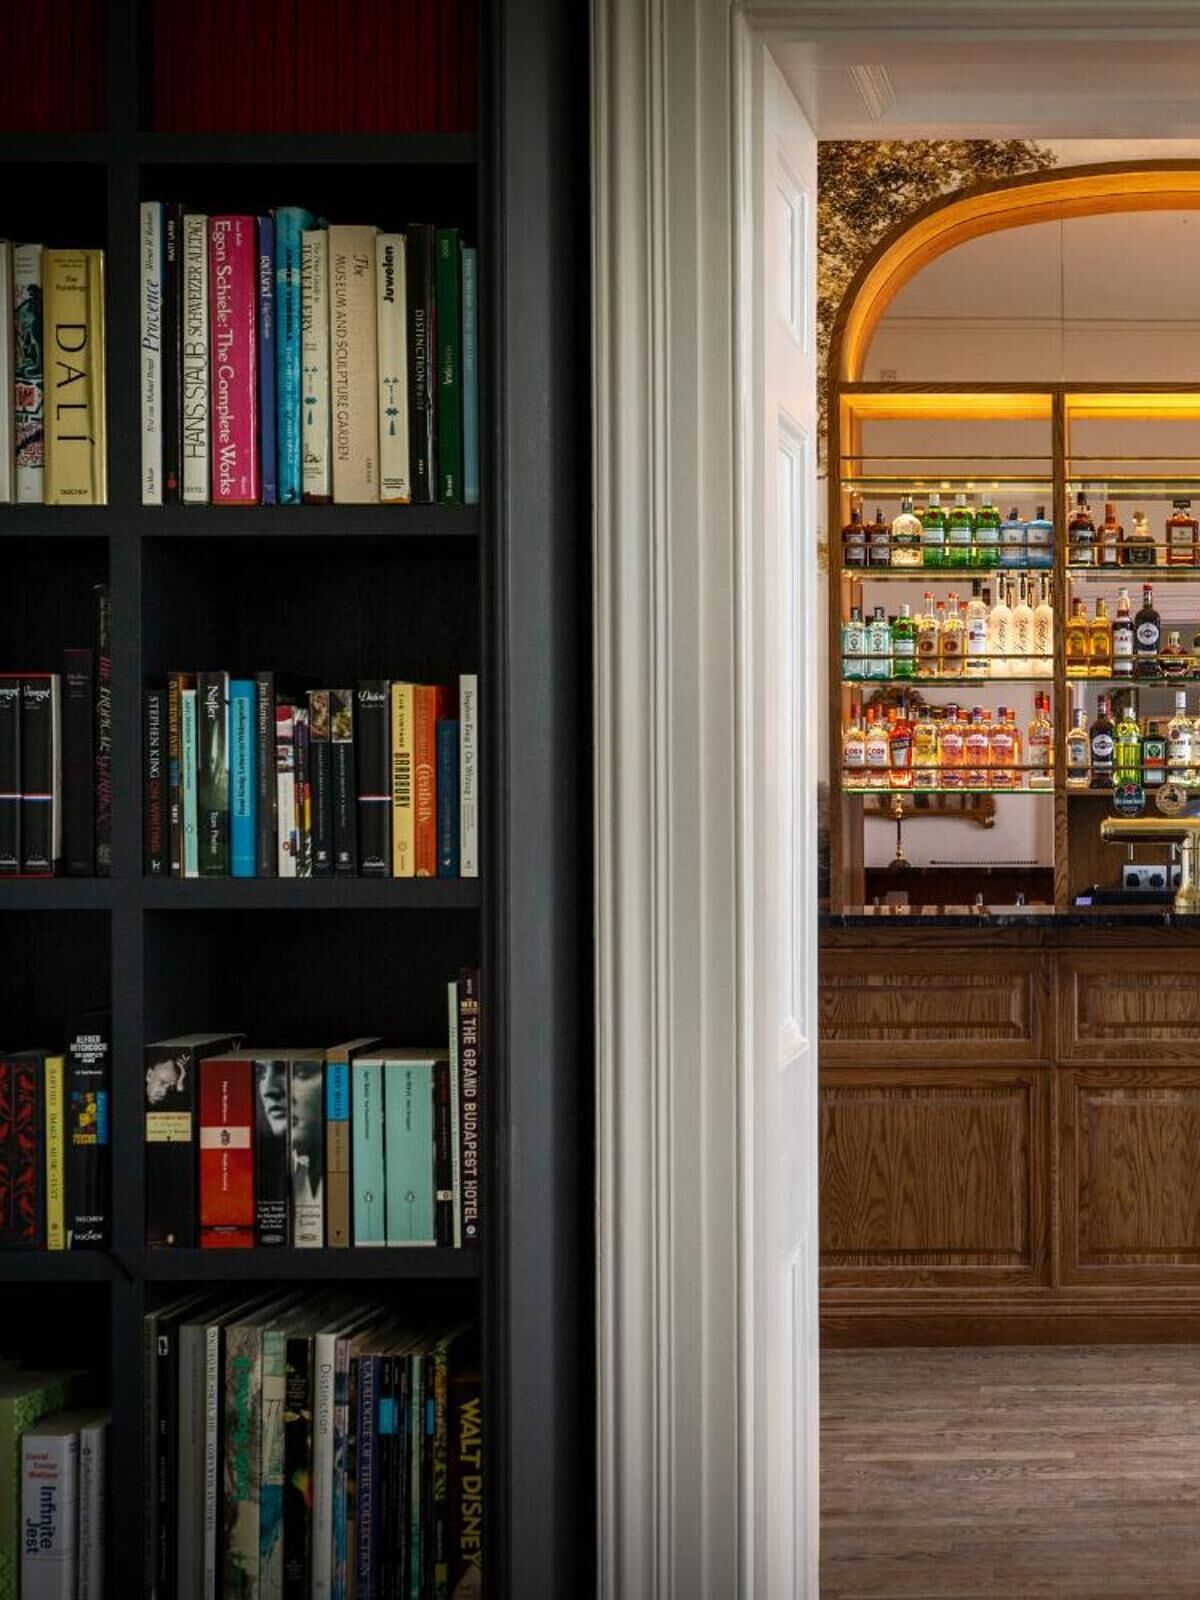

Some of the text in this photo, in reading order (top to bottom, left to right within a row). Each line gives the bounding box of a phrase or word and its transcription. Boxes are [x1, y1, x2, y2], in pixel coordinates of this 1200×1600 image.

[353, 253, 370, 278] The
[383, 245, 396, 303] Juwelen
[141, 279, 160, 352] Provence
[186, 266, 203, 337] SCHWEIZER
[184, 342, 207, 400] STAUB
[212, 220, 237, 496] Egon Schiele: The Complete Works
[334, 254, 350, 461] MUSEUM AND SCULPTURE GARDEN
[414, 309, 426, 382] DISTINCTION
[56, 323, 95, 445] DALÍ
[184, 403, 206, 459] HANS
[149, 696, 160, 747] STEPHEN
[149, 749, 161, 779] KING
[394, 752, 411, 809] BRADBURY
[415, 764, 433, 824] Creativity
[462, 1017, 478, 1223] THE GRAND BUDAPEST HOTEL
[318, 1363, 333, 1435] Distinction
[360, 1358, 373, 1577] CATALOGUE OF THE COLLECTION
[459, 1397, 483, 1568] WALT DISNEY
[25, 1518, 43, 1556] Jest
[39, 1485, 57, 1550] Infinite
